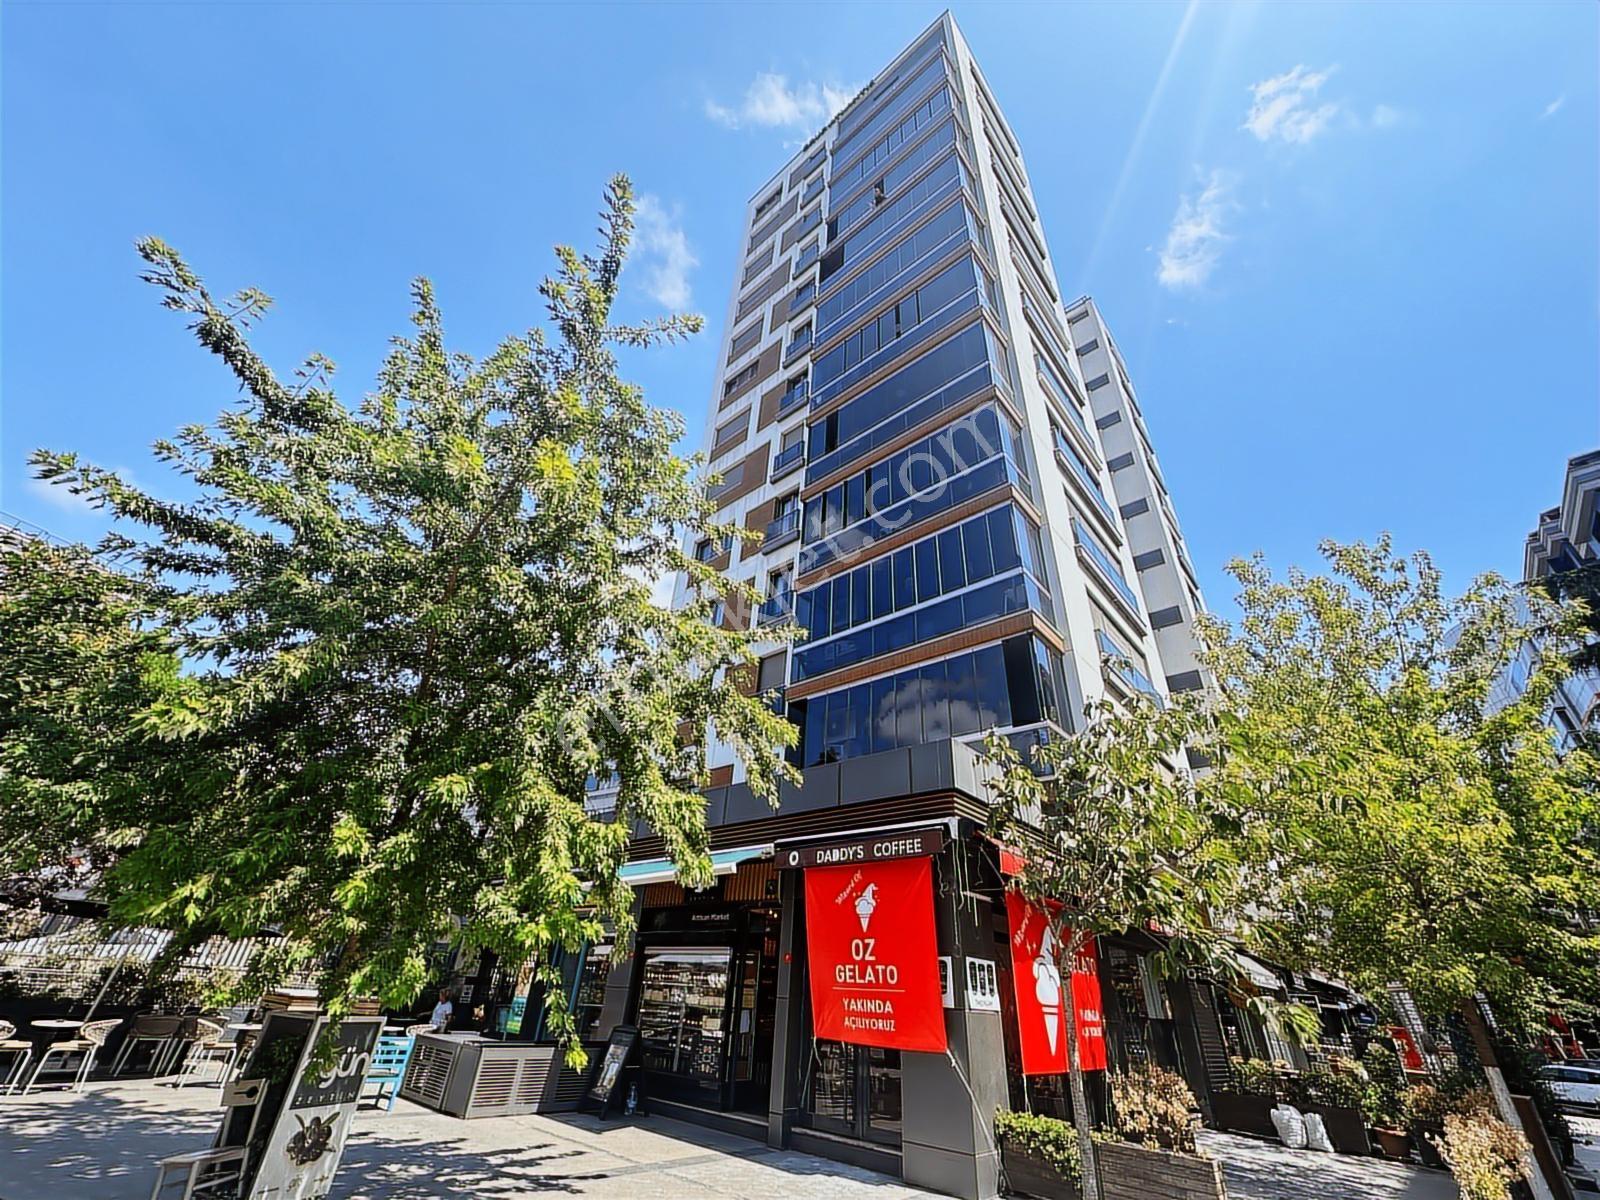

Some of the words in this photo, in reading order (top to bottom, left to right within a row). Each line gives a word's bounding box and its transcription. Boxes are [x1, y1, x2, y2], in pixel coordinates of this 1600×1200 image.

[873, 839, 922, 856] COFFEE
[852, 938, 876, 961] OZ
[835, 964, 898, 985] GELATO
[842, 998, 894, 1014] YAKINDA
[844, 1016, 896, 1032] AÇILIYORUZ
